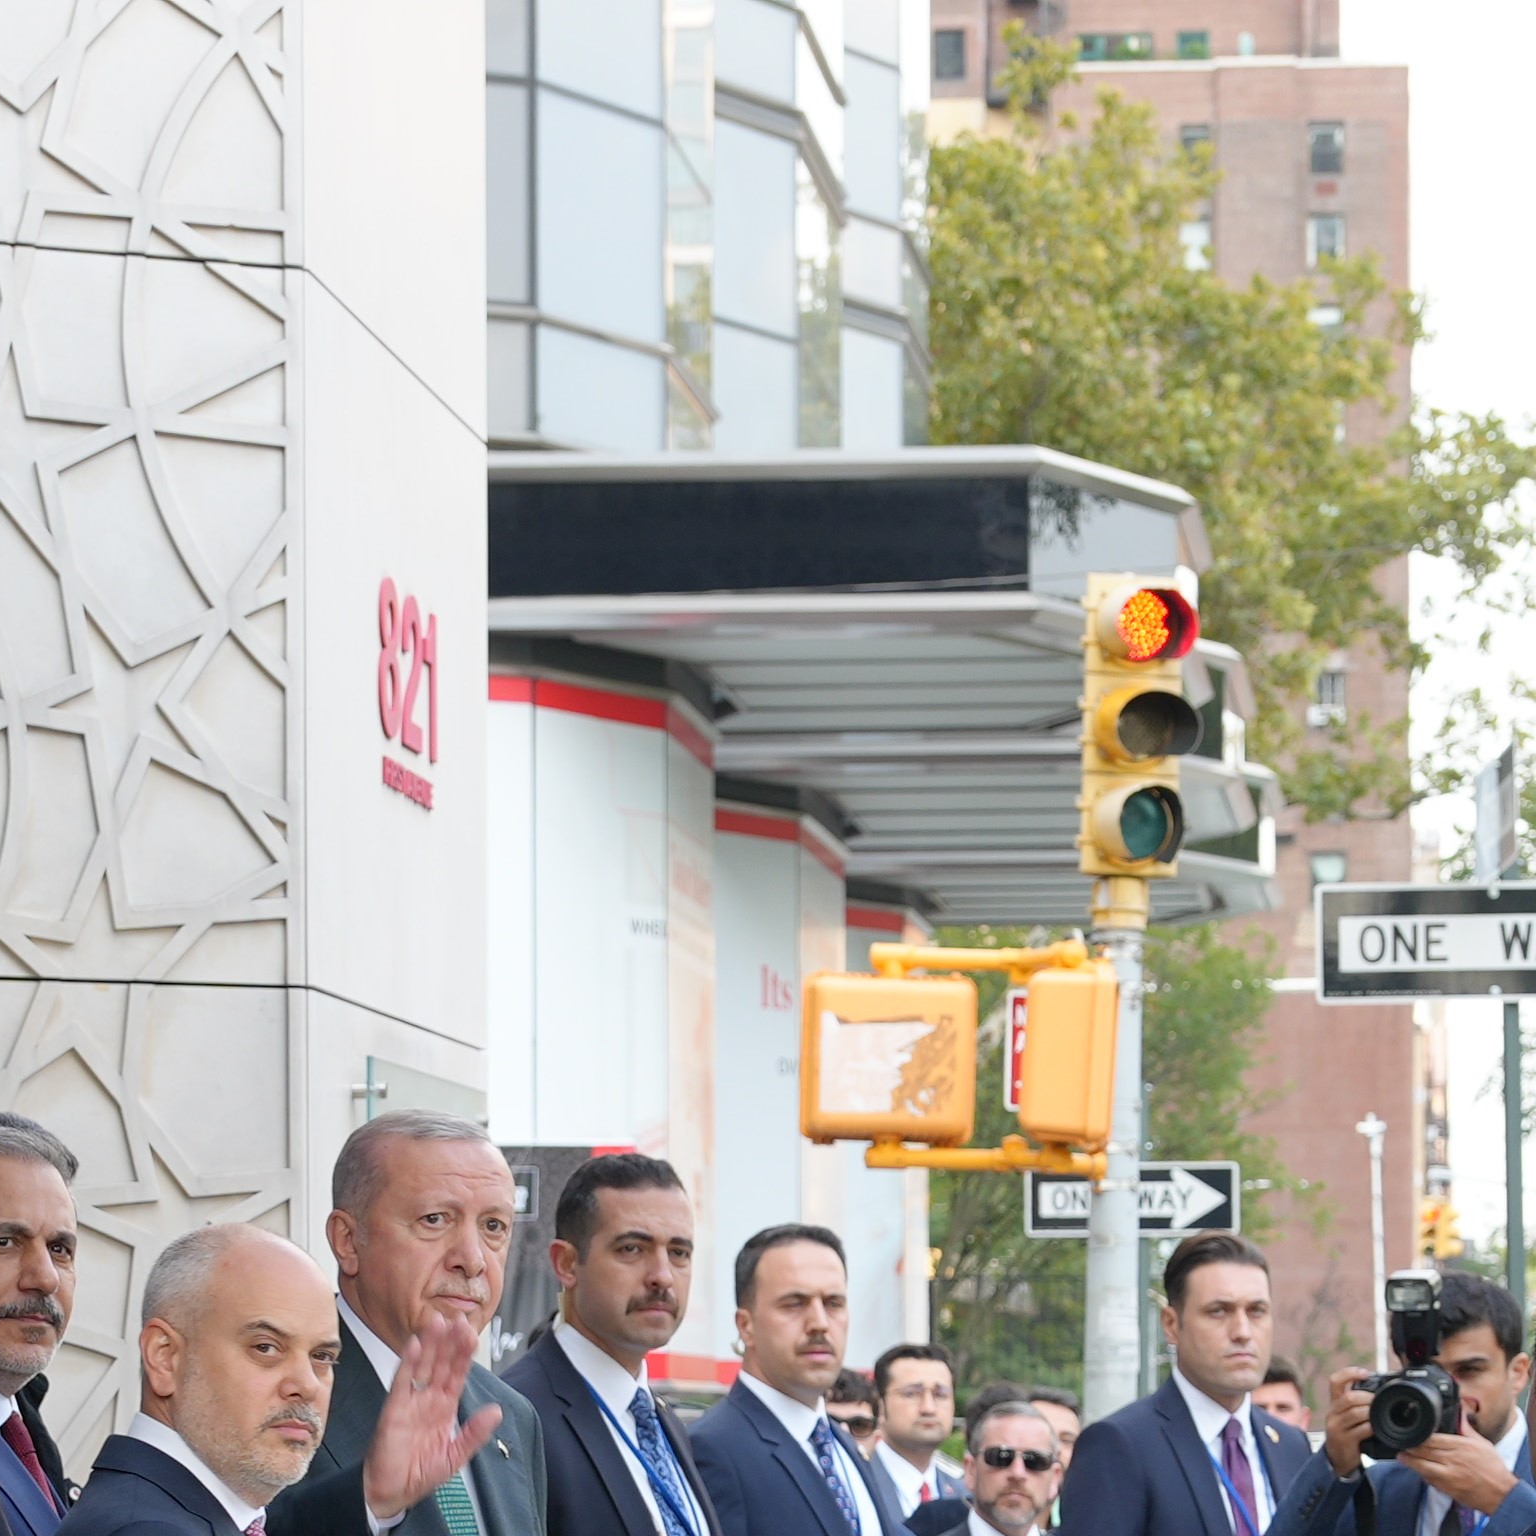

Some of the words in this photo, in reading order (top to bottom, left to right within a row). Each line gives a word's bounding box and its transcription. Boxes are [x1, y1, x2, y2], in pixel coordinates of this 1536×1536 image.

[377, 575, 438, 766] 821
[1359, 923, 1448, 963] ONE
[1053, 1184, 1090, 1211] ON
[1138, 1183, 1195, 1210] WAY
